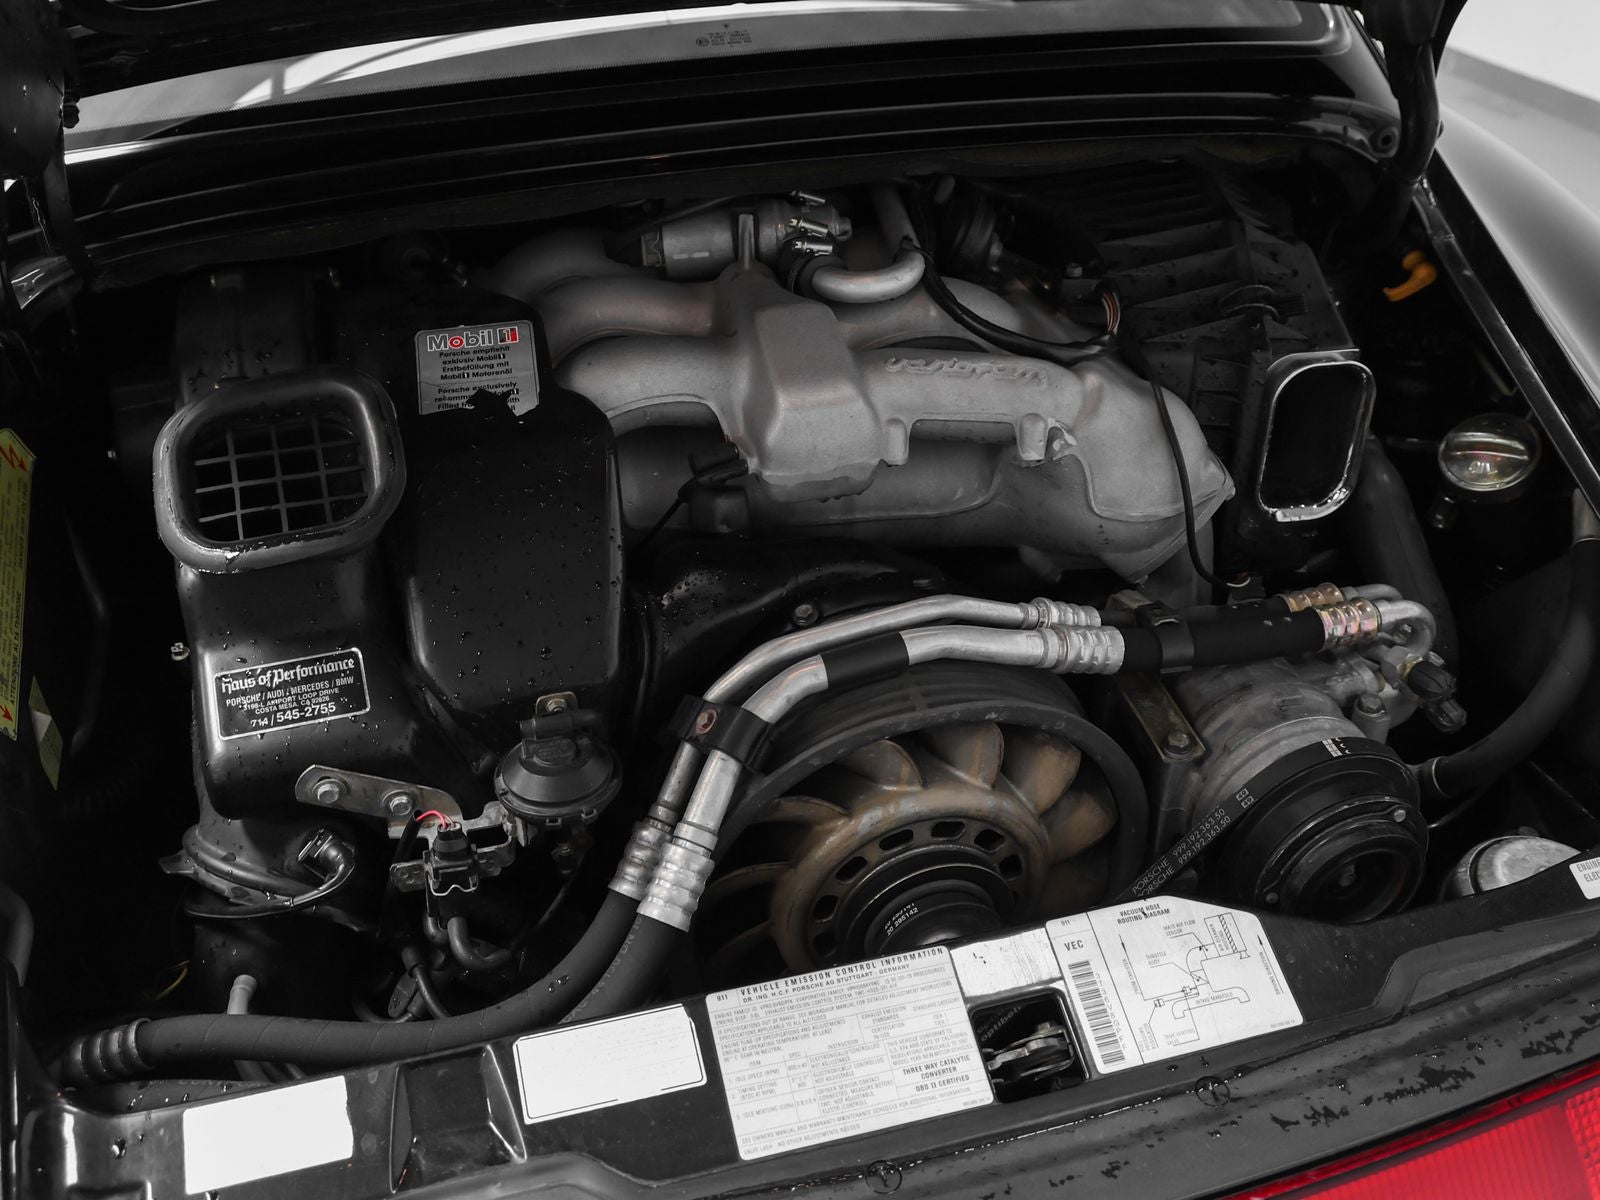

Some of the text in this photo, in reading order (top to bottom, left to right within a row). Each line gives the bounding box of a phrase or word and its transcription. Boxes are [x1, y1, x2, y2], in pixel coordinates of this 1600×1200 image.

[427, 329, 493, 351] Mobil
[440, 346, 510, 358] Porsche empfiehlt
[442, 356, 474, 365] exklusiv
[443, 363, 494, 373] Erstbefüllung
[472, 368, 512, 378] Motorenöl
[438, 386, 470, 394] Porsche
[221, 658, 355, 695] Haus of Performance
[226, 693, 260, 707] PORSCHE
[267, 689, 284, 699] AUDI
[291, 680, 330, 695] MERCEDES
[336, 676, 354, 687] BMW
[267, 695, 297, 706] AIRPORT
[298, 692, 317, 701] LOOP
[319, 688, 339, 697] DRIVE
[255, 705, 277, 715] COSTA
[276, 702, 336, 723] 545-2755
[1132, 857, 1170, 894] PORSCHE
[1139, 865, 1176, 897] ORSCHE
[1117, 908, 1170, 925] ROUTING DIAGRAM
[1119, 903, 1161, 917] VACUUM HOSE
[1064, 939, 1084, 951] VEC
[740, 981, 780, 996] VEHICLE
[784, 971, 831, 987] EMISSION
[835, 962, 877, 976] CONTROL
[880, 948, 944, 967] INFORMATION
[792, 982, 824, 993] PORSCHE
[836, 972, 873, 984] STUTTGART
[878, 964, 911, 975] GERMANY
[716, 993, 728, 1001] 911
[902, 1054, 971, 1076] THREE WAY CATALYTIC
[920, 1066, 958, 1080] CONVERTER
[915, 1083, 930, 1093] OBD
[937, 1074, 971, 1088] CERTIFIED
